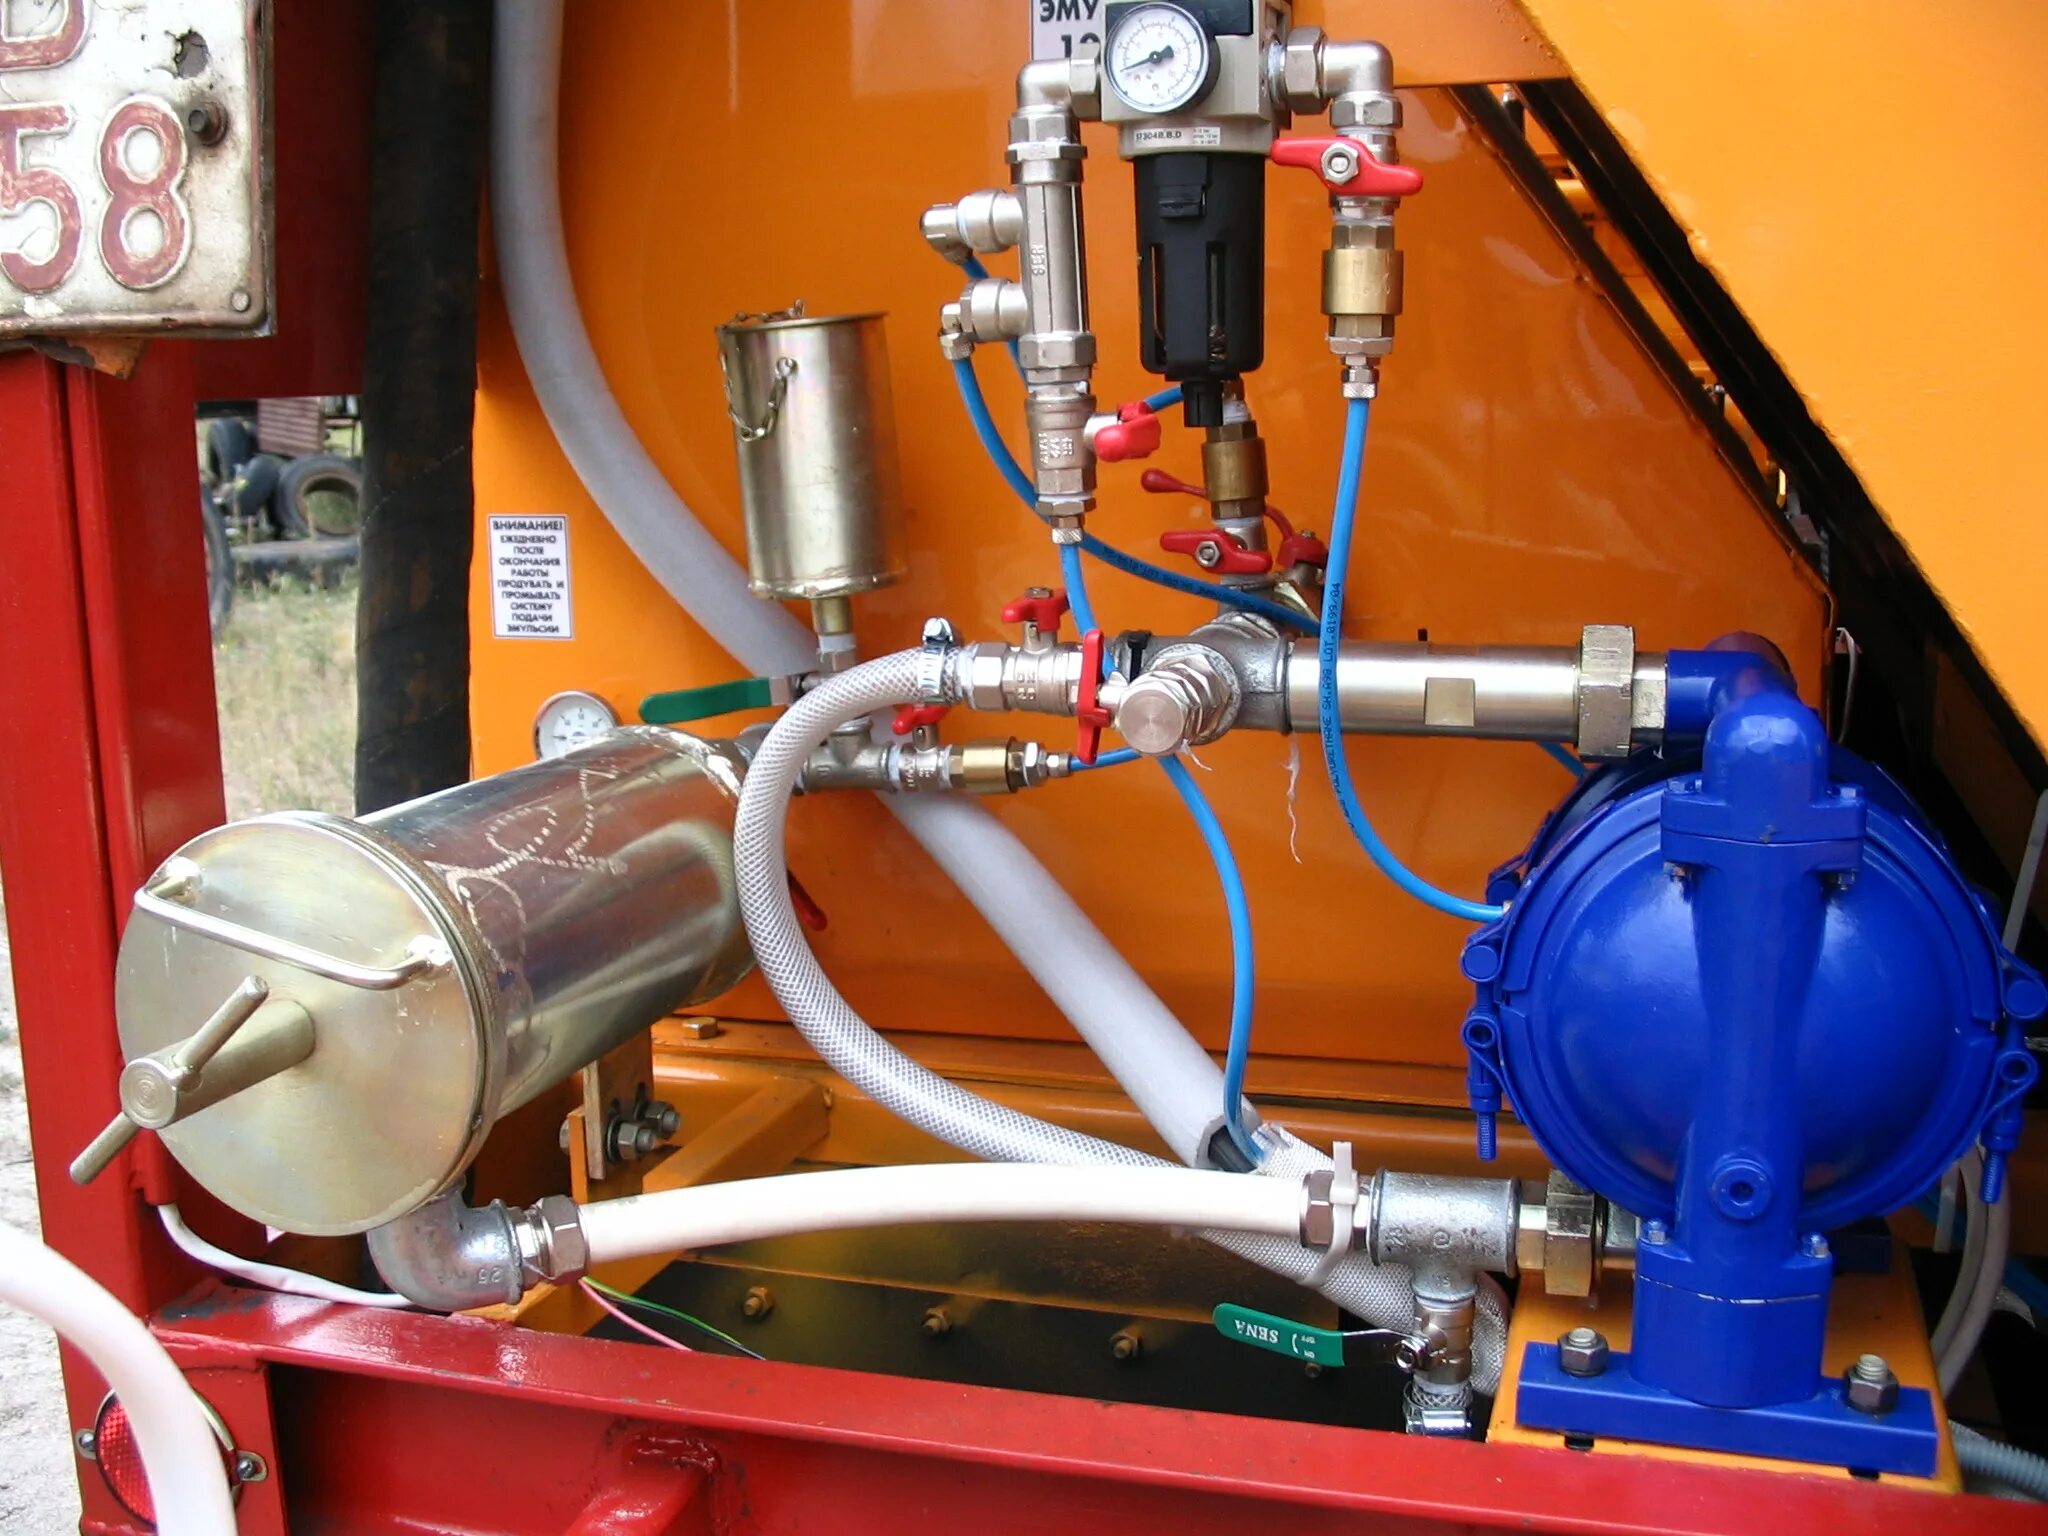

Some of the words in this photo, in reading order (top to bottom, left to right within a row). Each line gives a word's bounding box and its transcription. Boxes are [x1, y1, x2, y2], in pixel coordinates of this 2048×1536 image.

[492, 520, 562, 530] ВНИМАНИЕ!
[500, 535, 557, 544] ЕЖЕДНЕВНО
[513, 546, 544, 555] ПОСЛЕ
[499, 557, 561, 566] ОКОНЧАНИЯ
[511, 568, 549, 577] РАБОТЫ
[497, 579, 552, 589] ПРОДУВАТЬ
[556, 580, 564, 589] И
[501, 591, 561, 600] ПРОМЫВАТЬ
[510, 602, 553, 611] СИСТЕМУ
[512, 613, 553, 622] ПОДАЧИ
[507, 624, 560, 634] ЭМУЛЬСИИ
[1234, 1319, 1280, 1344] SENA
